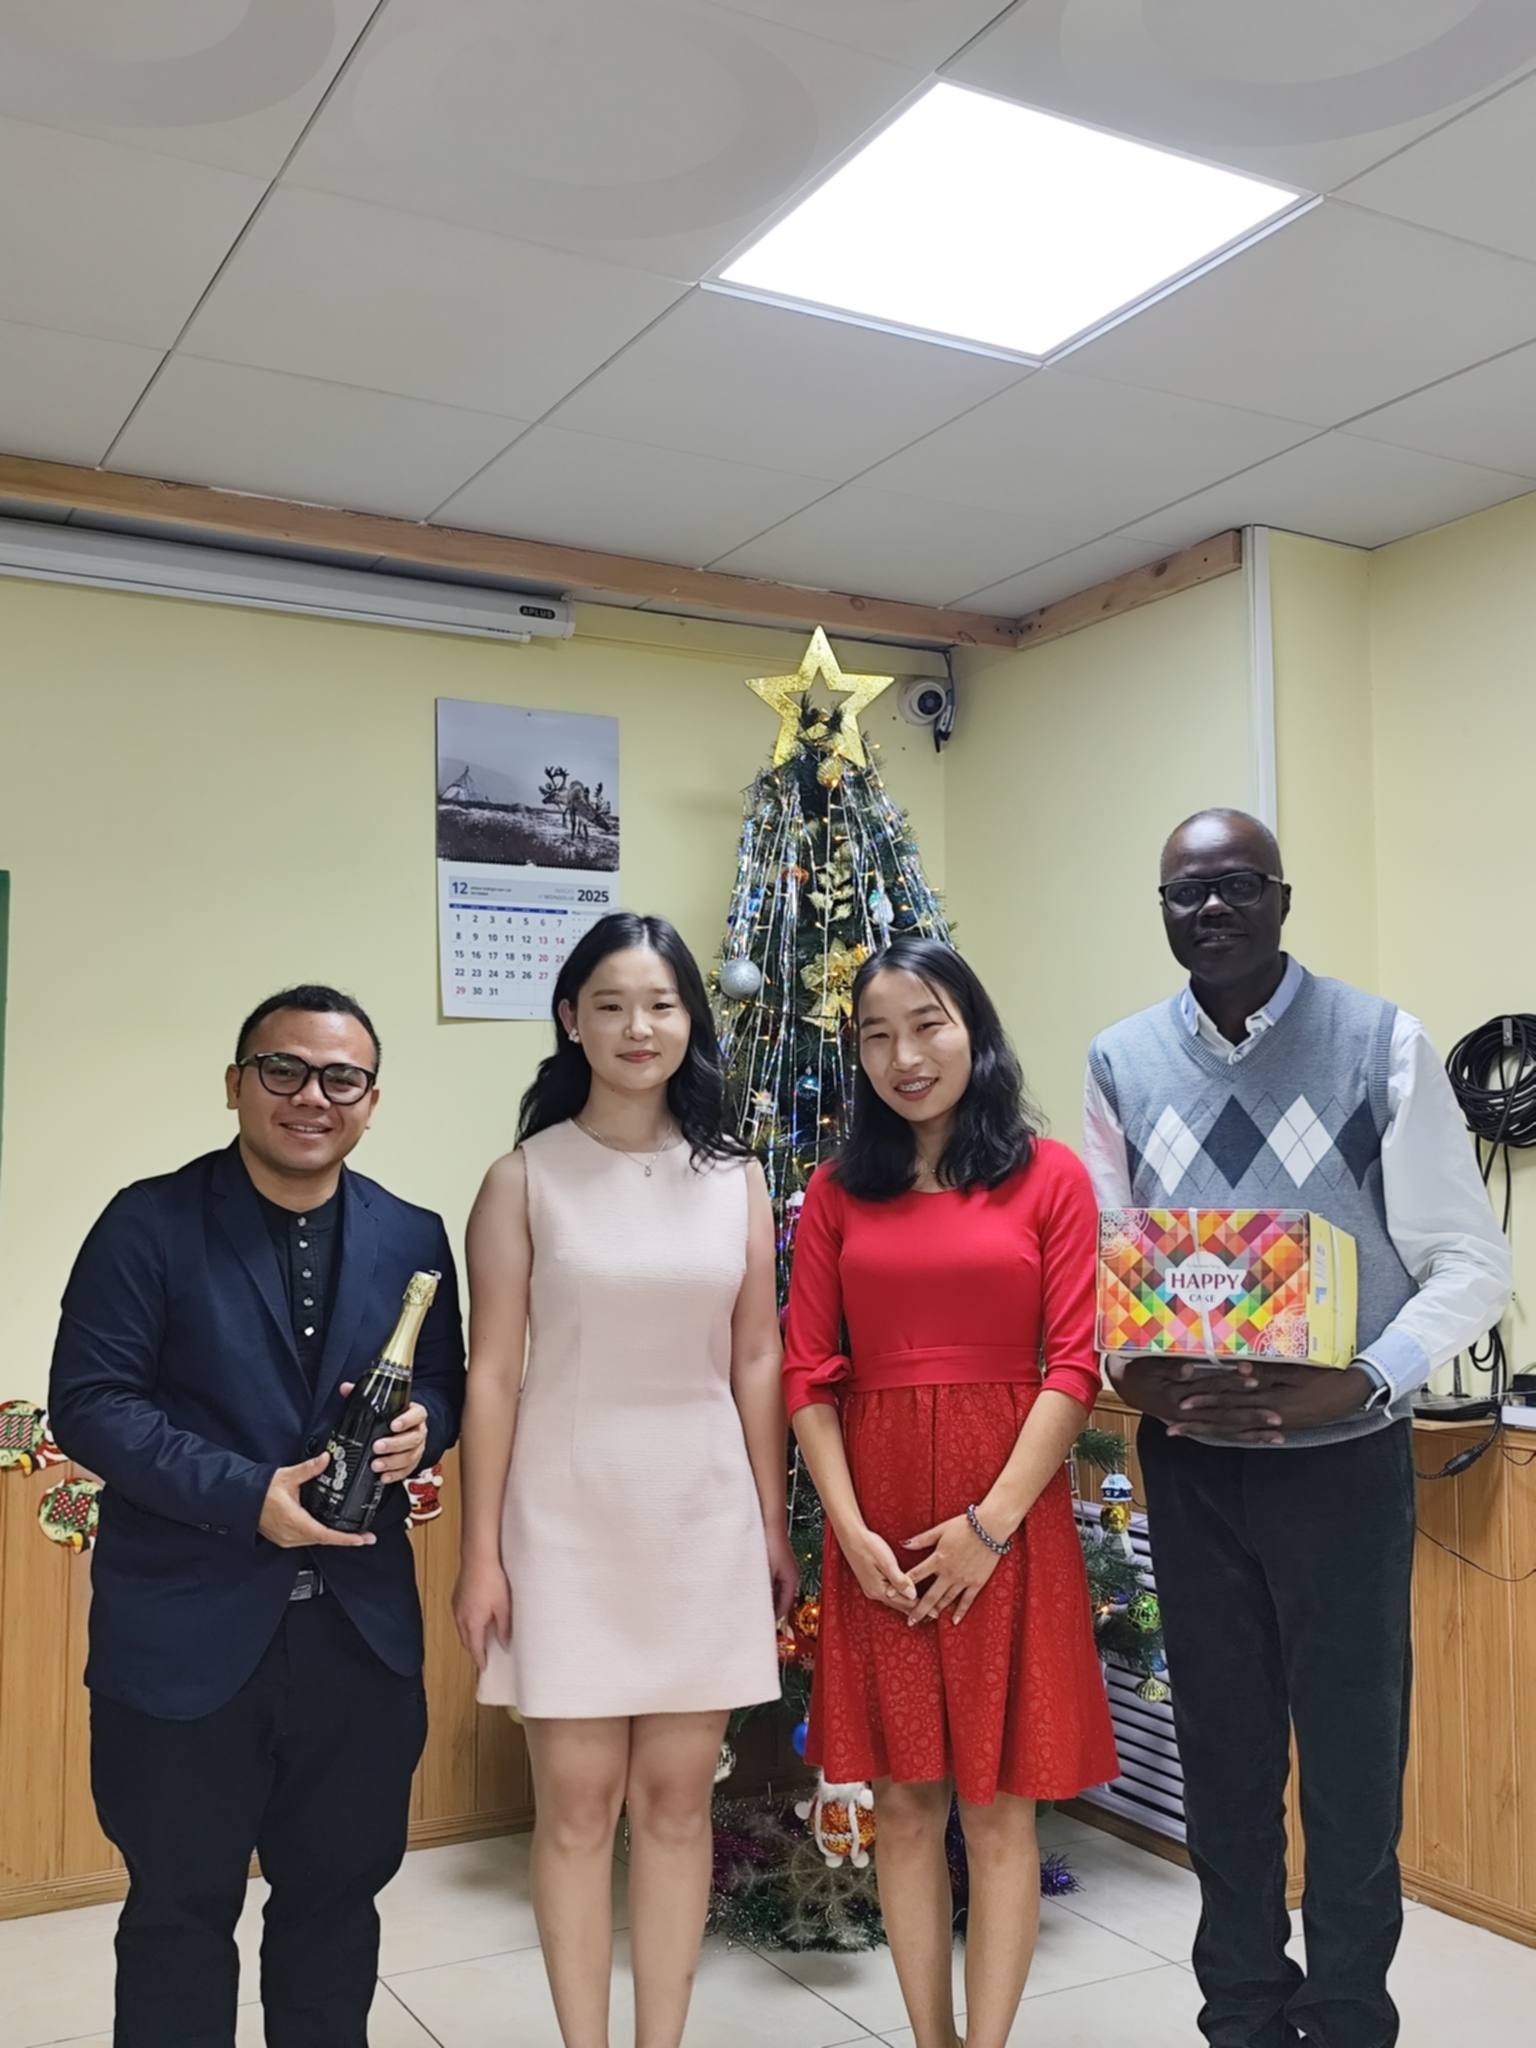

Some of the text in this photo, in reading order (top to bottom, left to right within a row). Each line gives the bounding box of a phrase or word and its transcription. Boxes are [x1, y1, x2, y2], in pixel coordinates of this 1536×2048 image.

[452, 882, 468, 895] 12
[577, 889, 609, 903] 2025
[488, 934, 498, 942] 10
[504, 934, 514, 942] 11
[522, 936, 532, 944] 12
[538, 936, 548, 944] 13
[556, 936, 566, 946] 14
[454, 950, 464, 958] 15
[472, 950, 482, 960] 16
[488, 952, 498, 960] 17
[506, 952, 516, 960] 18
[522, 954, 532, 962] 19
[454, 968, 464, 976] 22
[472, 968, 482, 978] 23
[488, 970, 498, 978] 24
[504, 970, 516, 978] 25
[522, 970, 532, 980] 26
[472, 986, 484, 996] 30
[488, 988, 498, 996] 31
[1171, 1272, 1239, 1290] HAPPY
